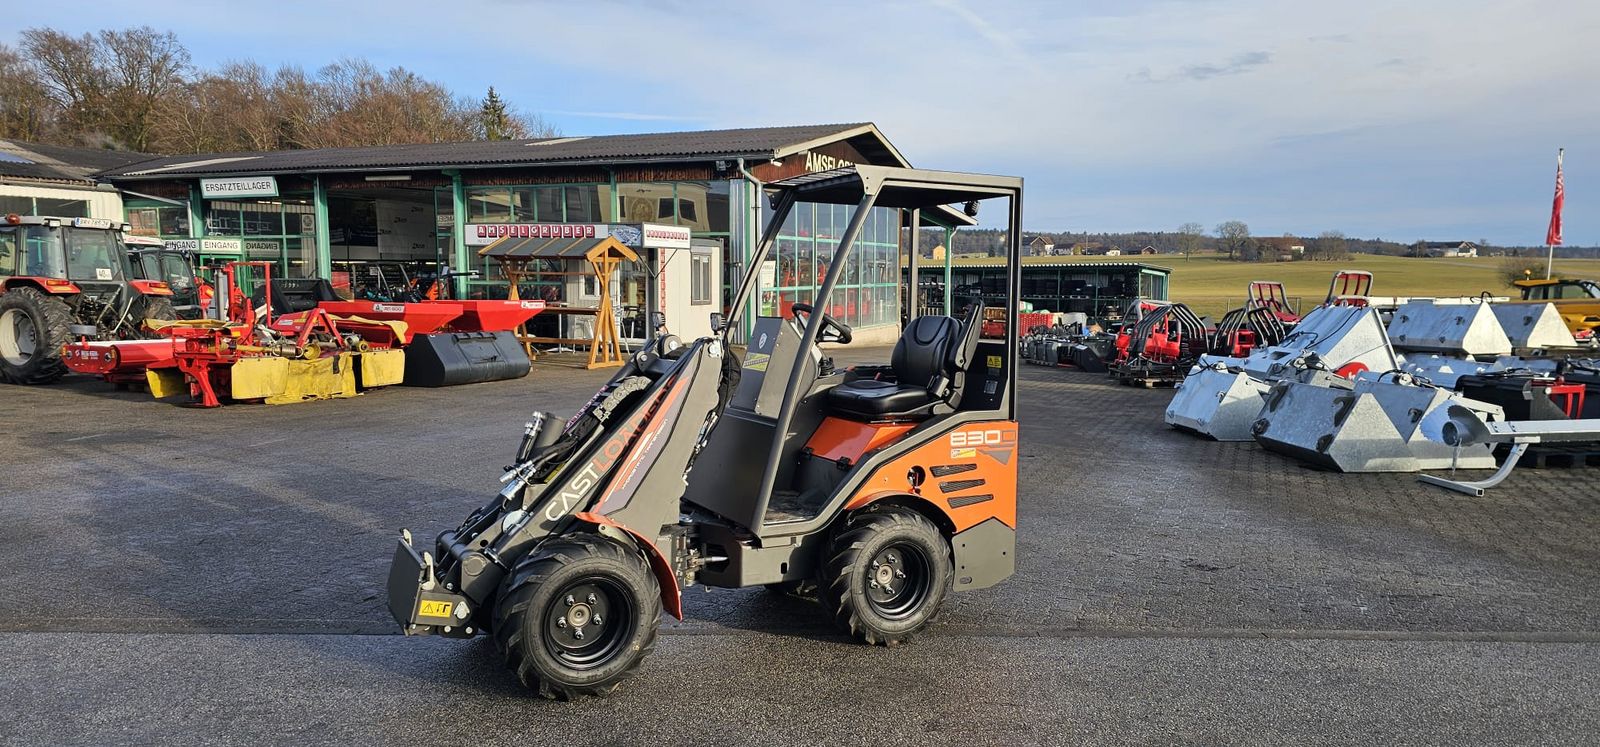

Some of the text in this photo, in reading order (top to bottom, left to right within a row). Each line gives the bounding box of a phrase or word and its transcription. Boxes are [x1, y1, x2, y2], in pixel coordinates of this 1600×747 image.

[805, 150, 854, 173] AMSEL
[205, 181, 271, 192] ERSATZTEILLAGER
[478, 226, 593, 235] AMSELGRUBER
[165, 241, 196, 250] EINGANG
[204, 241, 238, 249] EINGANG
